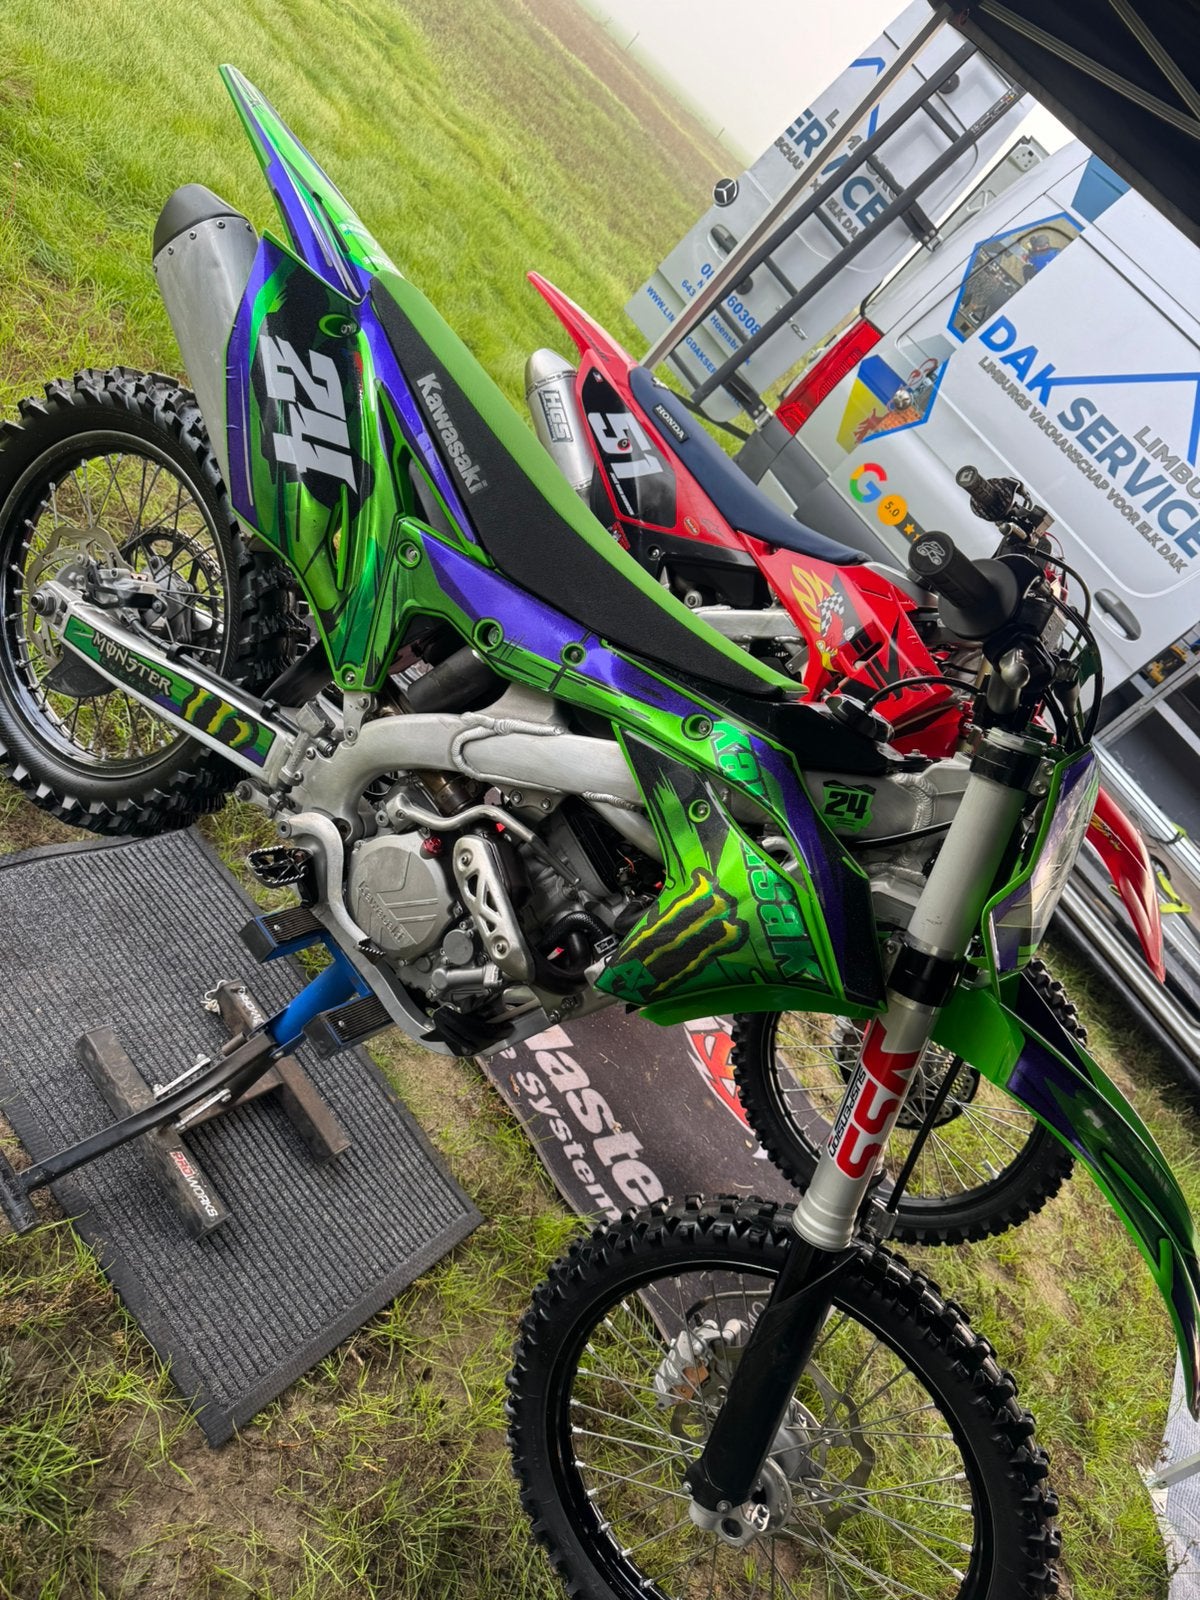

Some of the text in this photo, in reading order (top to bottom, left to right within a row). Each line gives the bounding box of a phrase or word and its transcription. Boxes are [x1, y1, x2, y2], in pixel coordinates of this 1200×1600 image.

[825, 197, 860, 239] ELK DA
[681, 280, 697, 297] 643
[726, 296, 761, 336] 60308
[258, 333, 358, 495] 24
[416, 372, 486, 495] Kawasaki
[544, 389, 571, 439] HGS
[587, 411, 664, 479] 51
[654, 404, 686, 439] HONDA
[979, 315, 1200, 559] DAK SERVICE
[978, 356, 1188, 574] LIMBURGS VAKMANSCHAP VOOR ELK DAK
[1133, 425, 1200, 503] LIMBU
[884, 499, 901, 518] 5.0
[93, 631, 171, 696] MONSTER
[823, 790, 869, 819] 24
[829, 1067, 867, 1158] SUSPENSION
[836, 1016, 920, 1179] YSS
